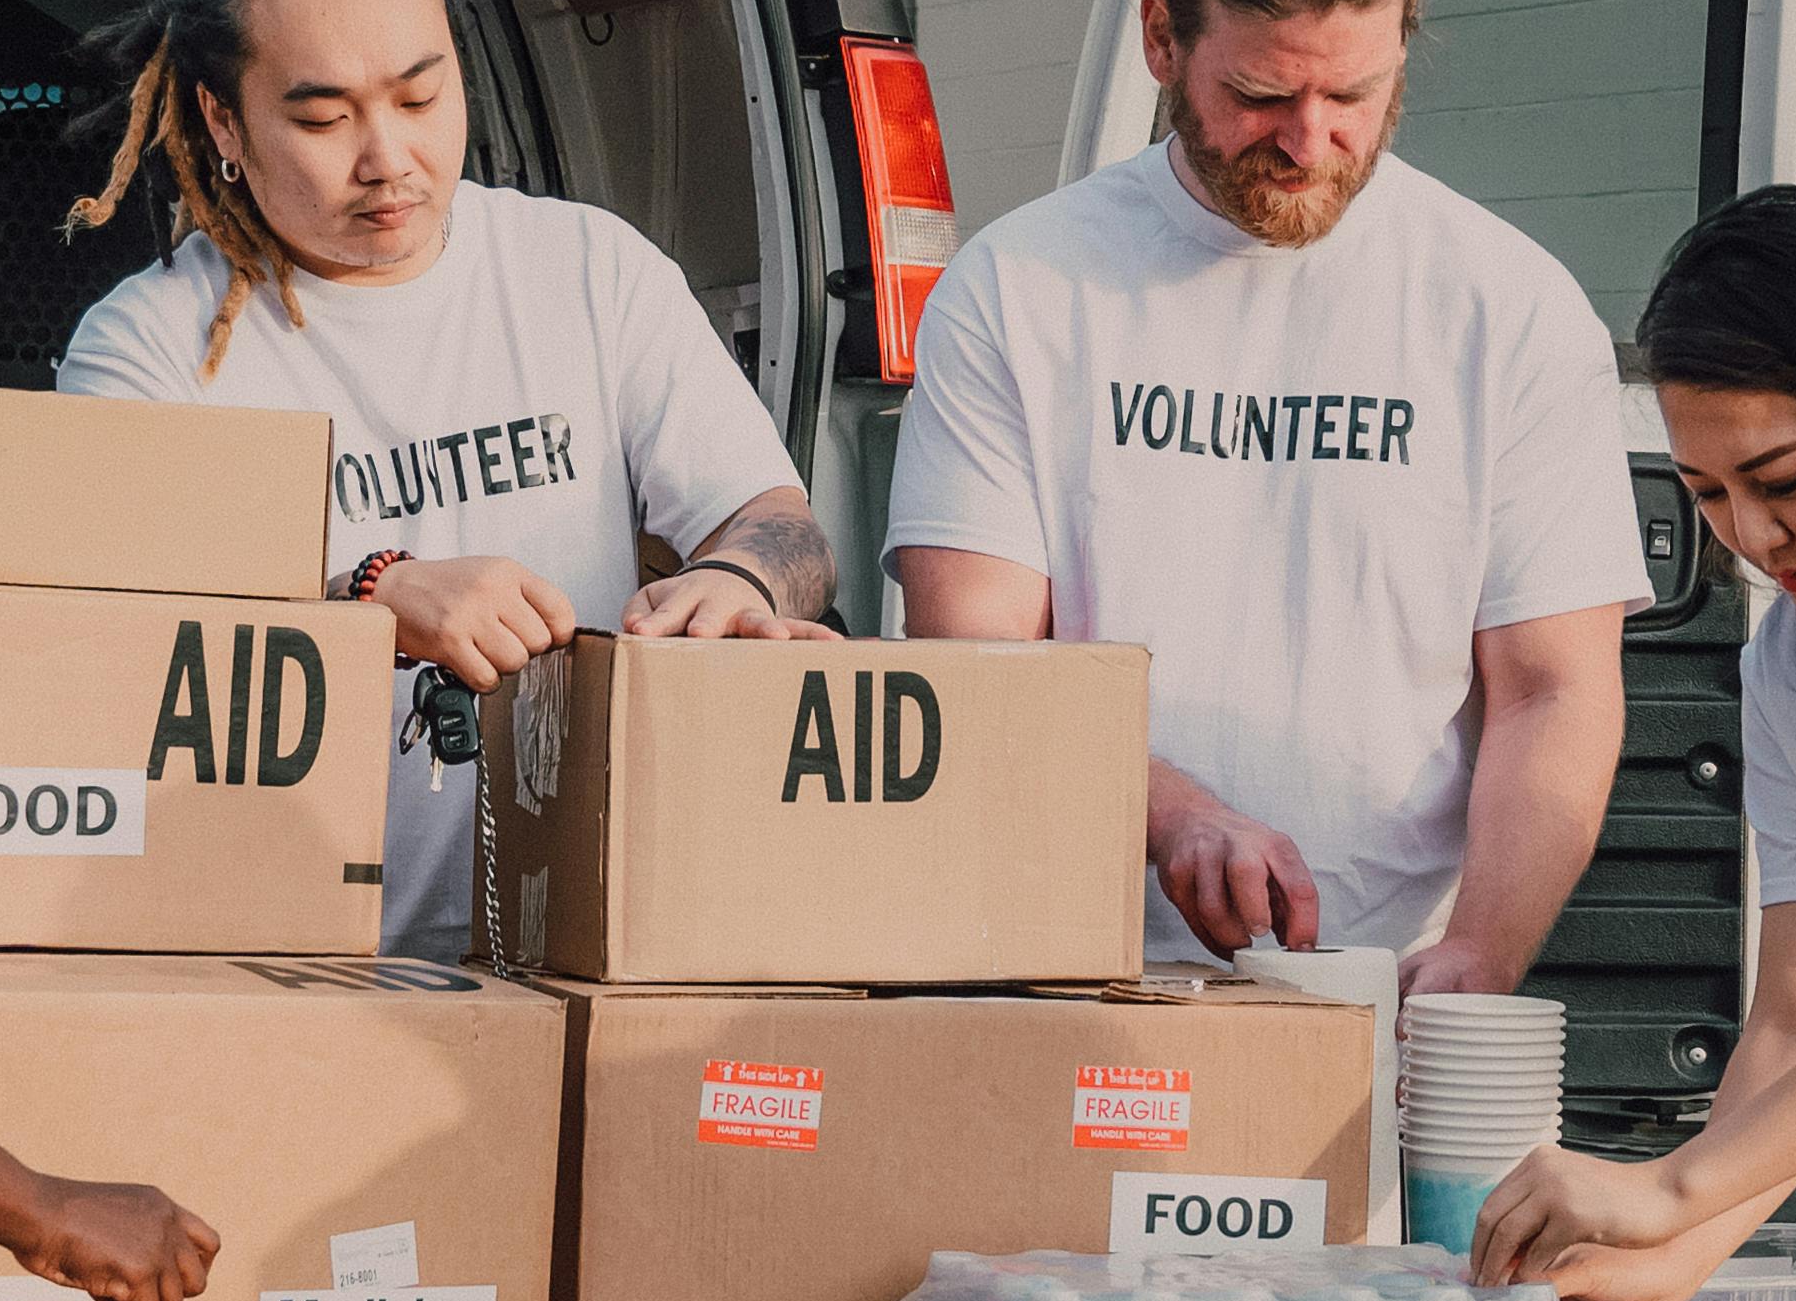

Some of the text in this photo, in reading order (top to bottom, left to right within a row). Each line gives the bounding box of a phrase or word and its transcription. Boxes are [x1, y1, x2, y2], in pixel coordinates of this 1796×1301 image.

[1110, 382, 1415, 465] VOLUNTEER
[335, 413, 577, 524] OLUNTEER
[146, 620, 327, 787] AID
[781, 670, 942, 804] AID
[225, 961, 484, 992] AID
[713, 1092, 812, 1120] FRAGILE
[1085, 1098, 1180, 1121] FRAGILE
[1144, 1193, 1295, 1241] FOOD
